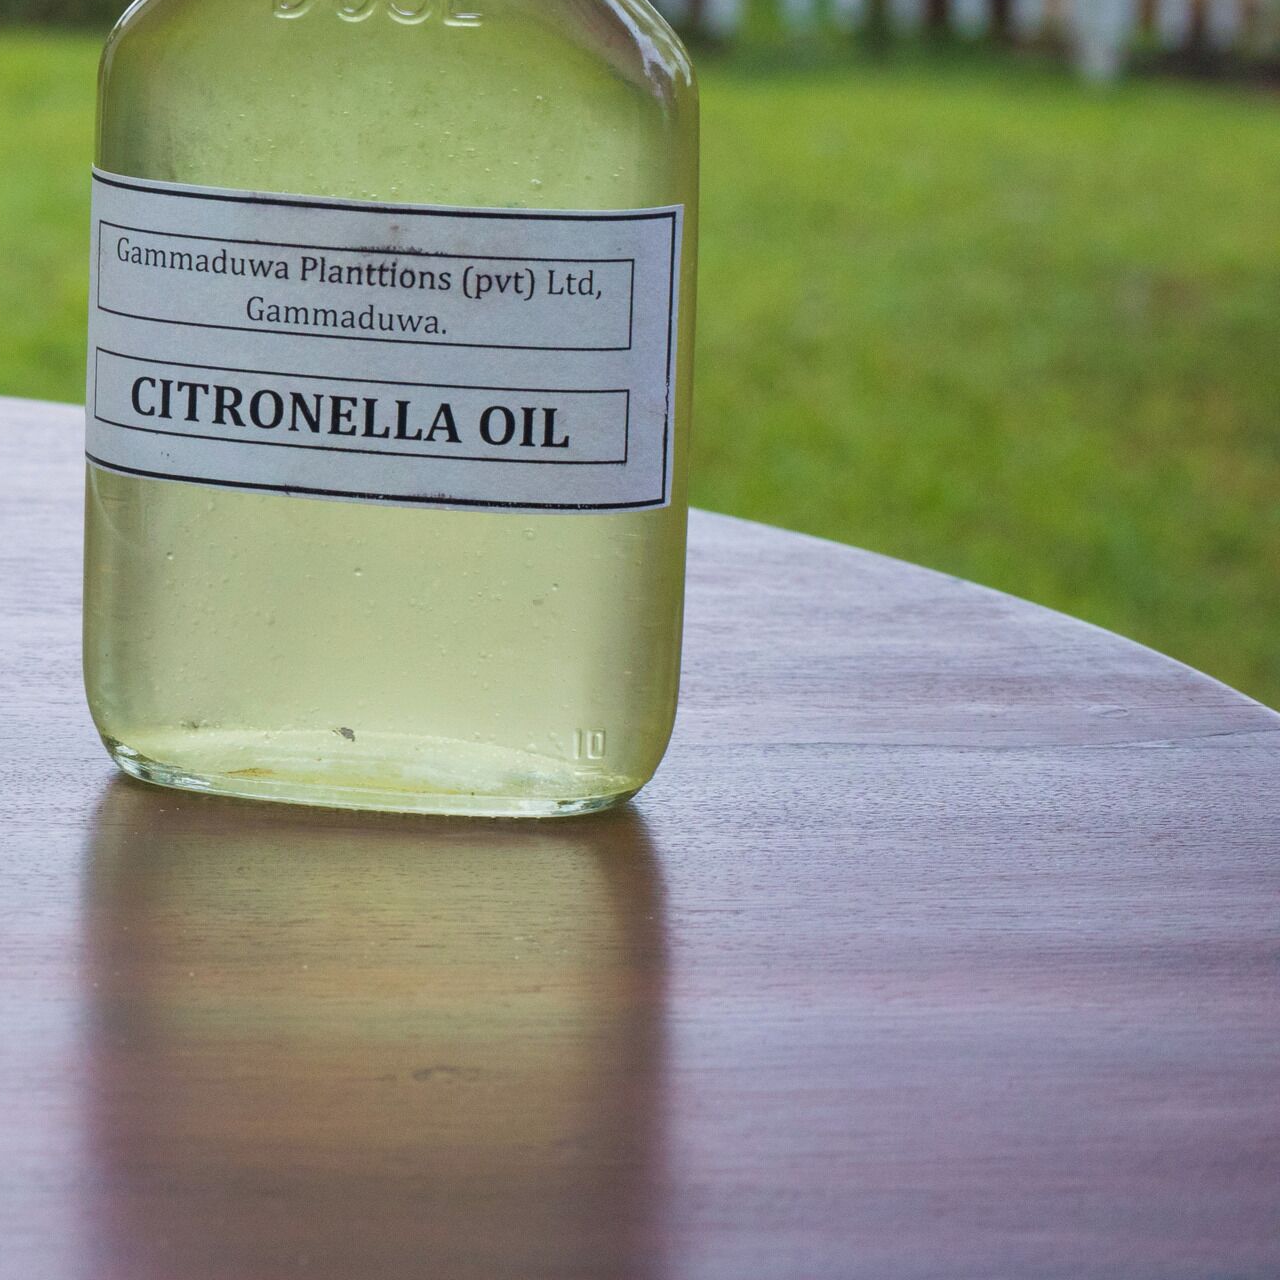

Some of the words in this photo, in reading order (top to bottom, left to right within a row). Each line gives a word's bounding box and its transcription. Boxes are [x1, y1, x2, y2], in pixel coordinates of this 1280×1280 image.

[117, 237, 289, 280] Gammaduwa
[301, 257, 451, 291] Planttions
[463, 266, 535, 301] (pvt)
[547, 270, 602, 301] Ltd,
[247, 296, 447, 335] Gammaduwa.
[131, 377, 462, 443] CITRONELLA
[479, 406, 570, 448] OIL
